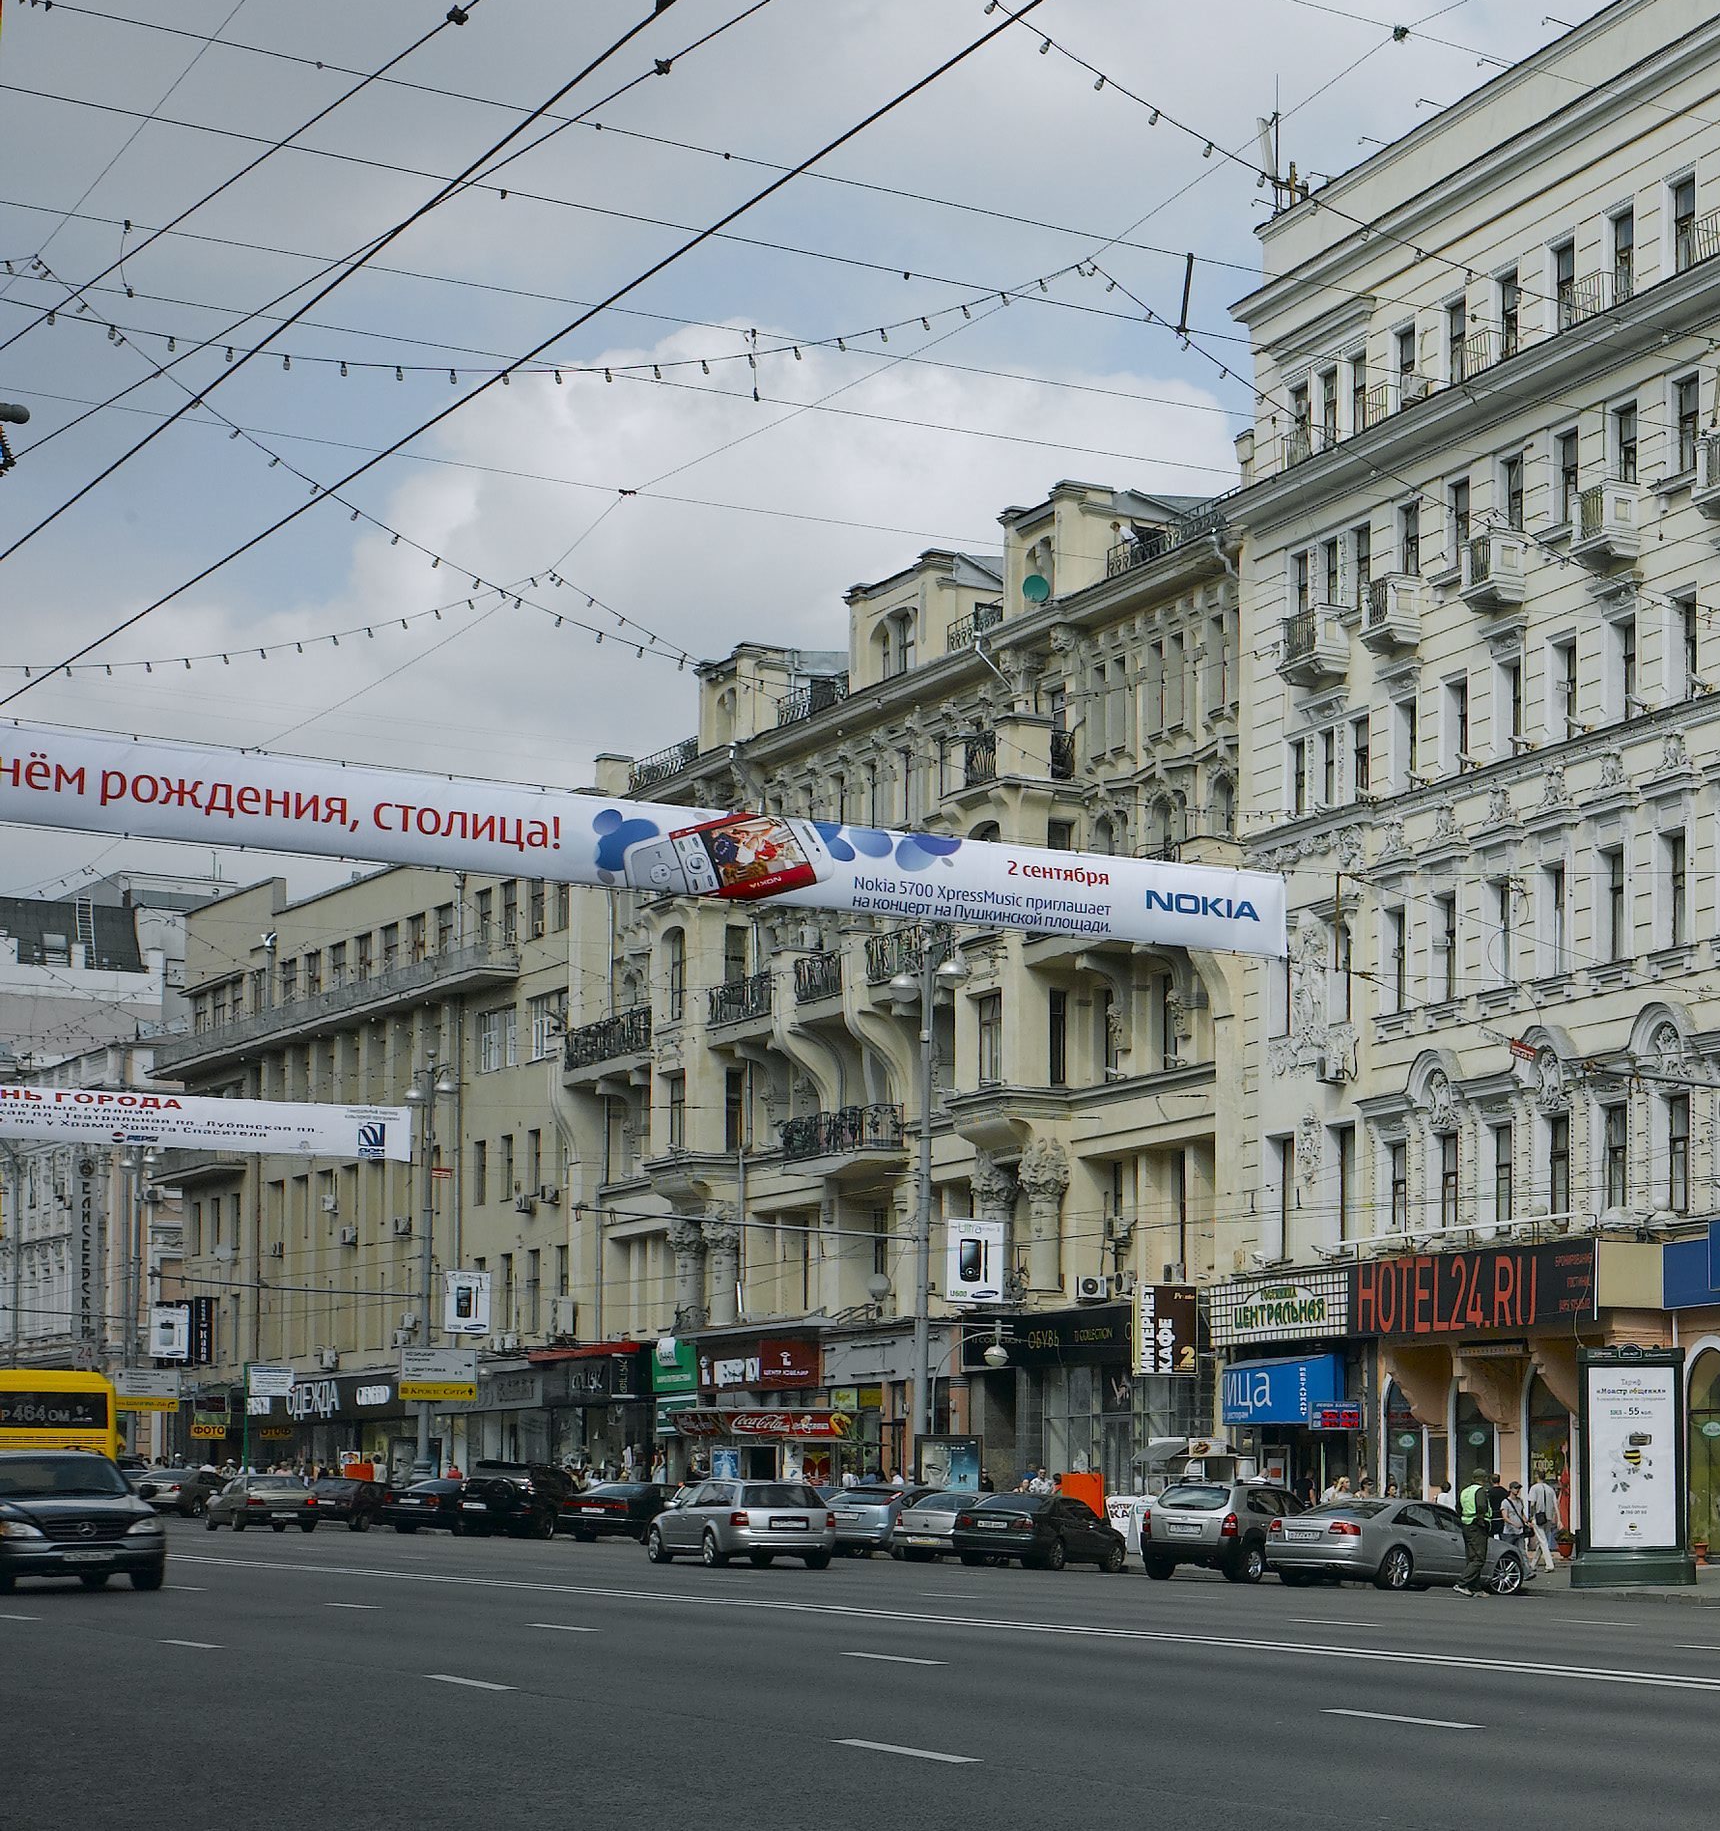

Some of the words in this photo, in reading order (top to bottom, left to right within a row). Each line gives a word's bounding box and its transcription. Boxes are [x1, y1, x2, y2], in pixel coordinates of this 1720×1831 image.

[100, 769, 359, 833] рождения,
[373, 802, 560, 852] столица!
[1007, 860, 1018, 876] 2
[1023, 861, 1110, 887] сентября
[854, 876, 896, 894] Nokia
[900, 882, 934, 898] 5700
[937, 885, 1023, 908] XpressMusic
[1026, 896, 1112, 917] приглашает
[1145, 889, 1261, 922] NOKIA
[852, 895, 870, 909] на
[873, 898, 932, 917] концерт
[934, 904, 951, 918] на
[954, 905, 1042, 926] Пушкинской
[1045, 915, 1112, 934] площади.
[55, 1092, 183, 1110] ГОРОДА
[60, 1119, 115, 1129] Храма
[120, 1122, 177, 1133] Христа
[126, 1134, 160, 1143] PEPSI
[949, 1289, 968, 1298] U600
[1259, 1285, 1298, 1301] ГОСТИНИЦА
[1357, 1255, 1537, 1334] HOTEL24.RU
[1234, 1297, 1326, 1330] ЦЕНТРАЛЬНАЯ
[1079, 1328, 1113, 1342] COLLECTION
[1140, 1285, 1155, 1374] ИНТЕРНЕТ
[1157, 1317, 1176, 1373] КАФЕ
[1027, 1330, 1060, 1350] ОБУВЬ
[77, 1346, 94, 1360] 24
[1180, 1345, 1196, 1364] 2
[286, 1380, 341, 1421] ОДЕЖДА
[1299, 1366, 1308, 1417] RESTAURANT
[1628, 1407, 1640, 1416] 55
[193, 1425, 225, 1435] ФОТО
[1108, 1502, 1132, 1511] ИНТЕР
[1109, 1509, 1131, 1519] КА
